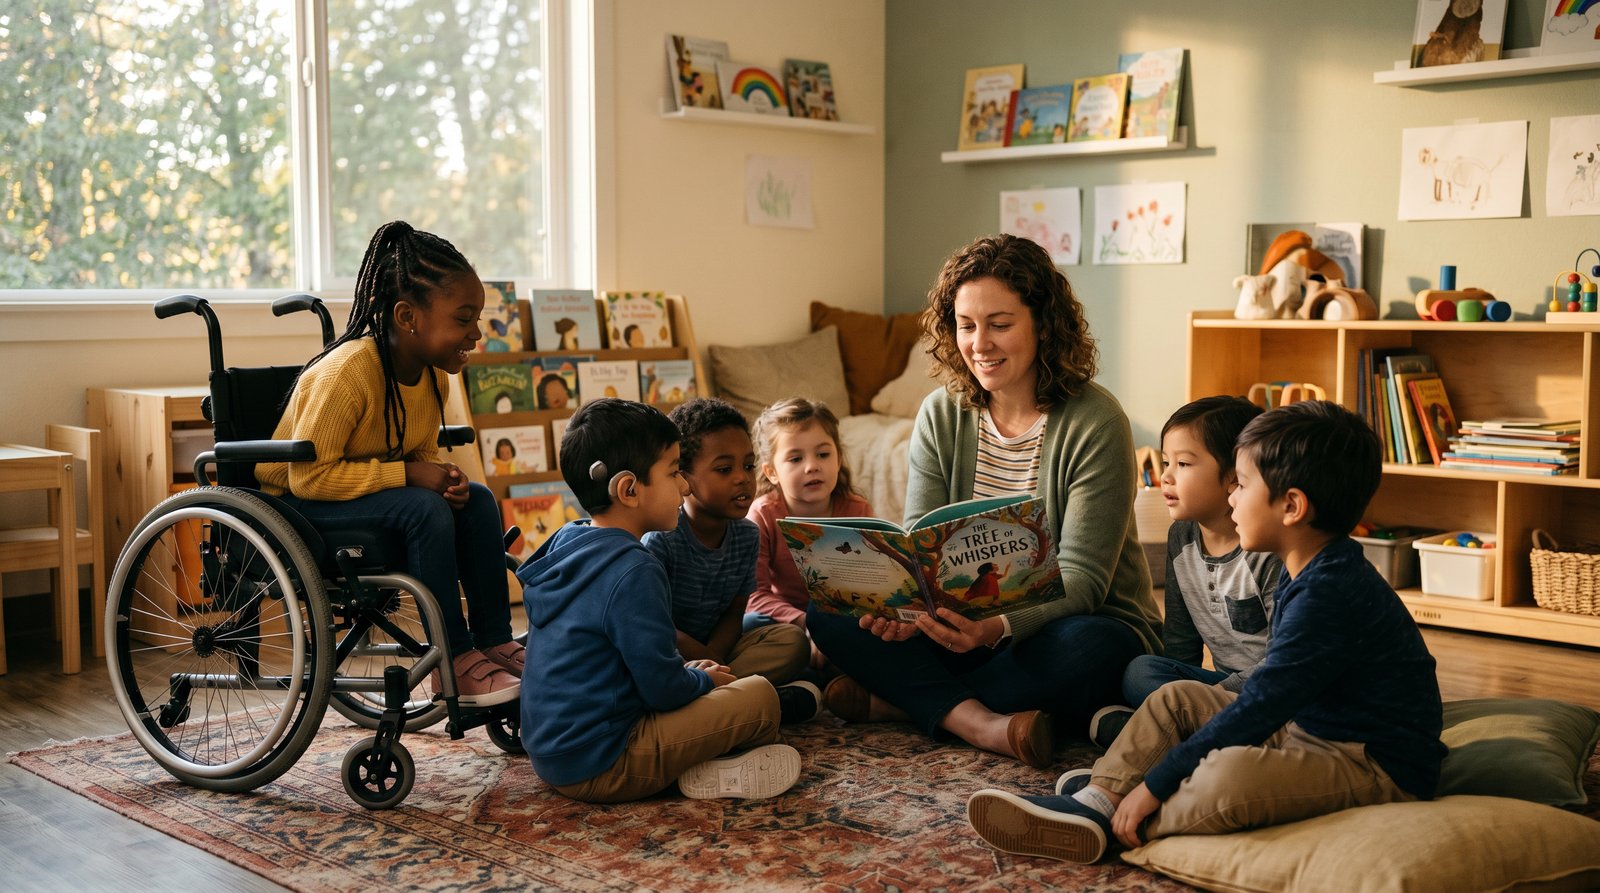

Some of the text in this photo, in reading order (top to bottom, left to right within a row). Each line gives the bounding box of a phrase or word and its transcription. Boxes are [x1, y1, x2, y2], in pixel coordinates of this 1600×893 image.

[972, 523, 988, 533] THE
[960, 529, 1013, 549] TREE OF
[948, 537, 1029, 567] WHISPERS
